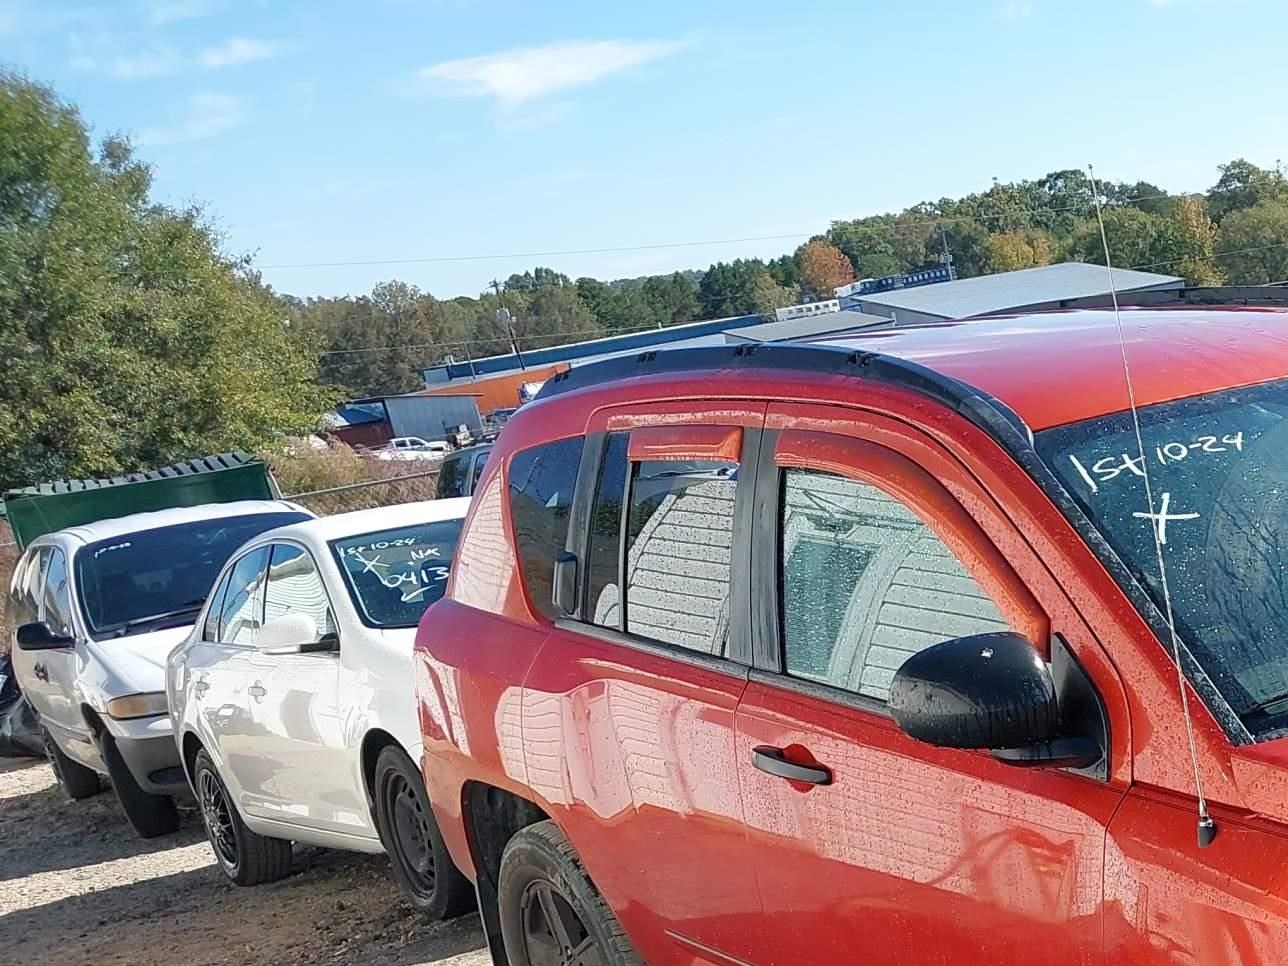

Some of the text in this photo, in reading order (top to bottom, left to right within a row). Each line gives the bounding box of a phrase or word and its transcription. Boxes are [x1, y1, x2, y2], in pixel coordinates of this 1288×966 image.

[1156, 431, 1244, 466] 10-24
[370, 537, 416, 550] 10-24
[383, 566, 450, 588] 0413
